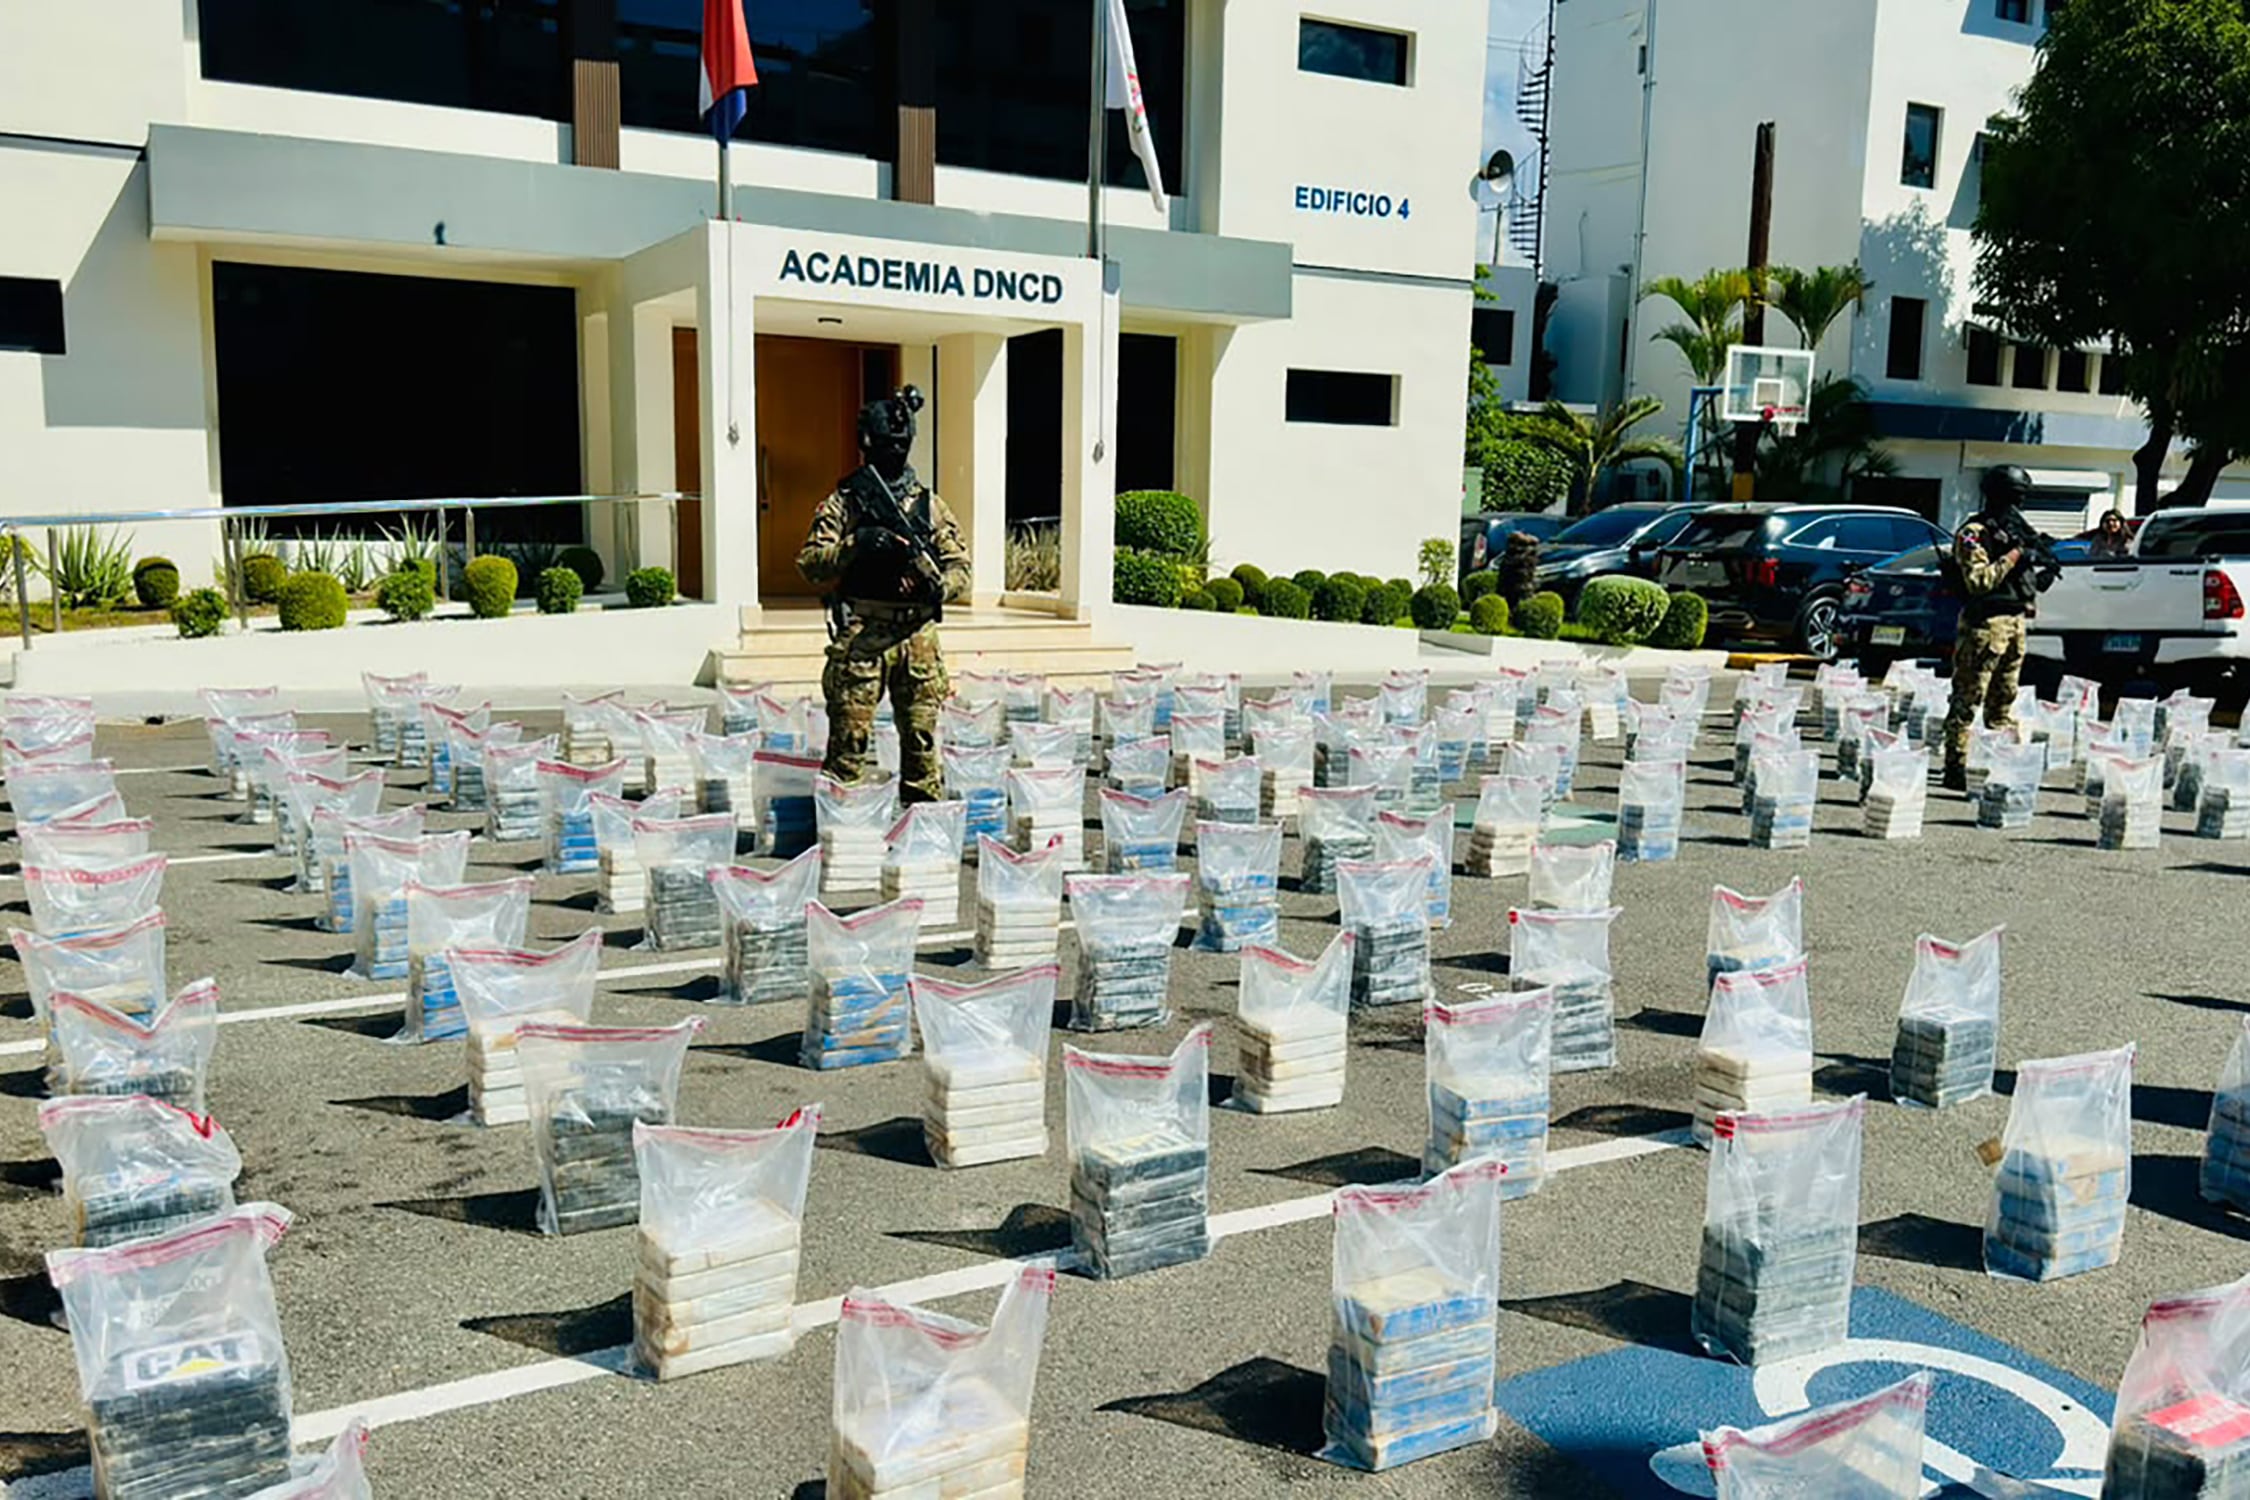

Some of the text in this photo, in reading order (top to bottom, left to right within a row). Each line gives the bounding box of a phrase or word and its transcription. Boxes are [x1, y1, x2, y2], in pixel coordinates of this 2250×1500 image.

[1295, 185, 1410, 220] EDIFICIO 4
[779, 249, 1063, 304] ACADEMIA DNCD
[136, 1337, 245, 1381] CAT
